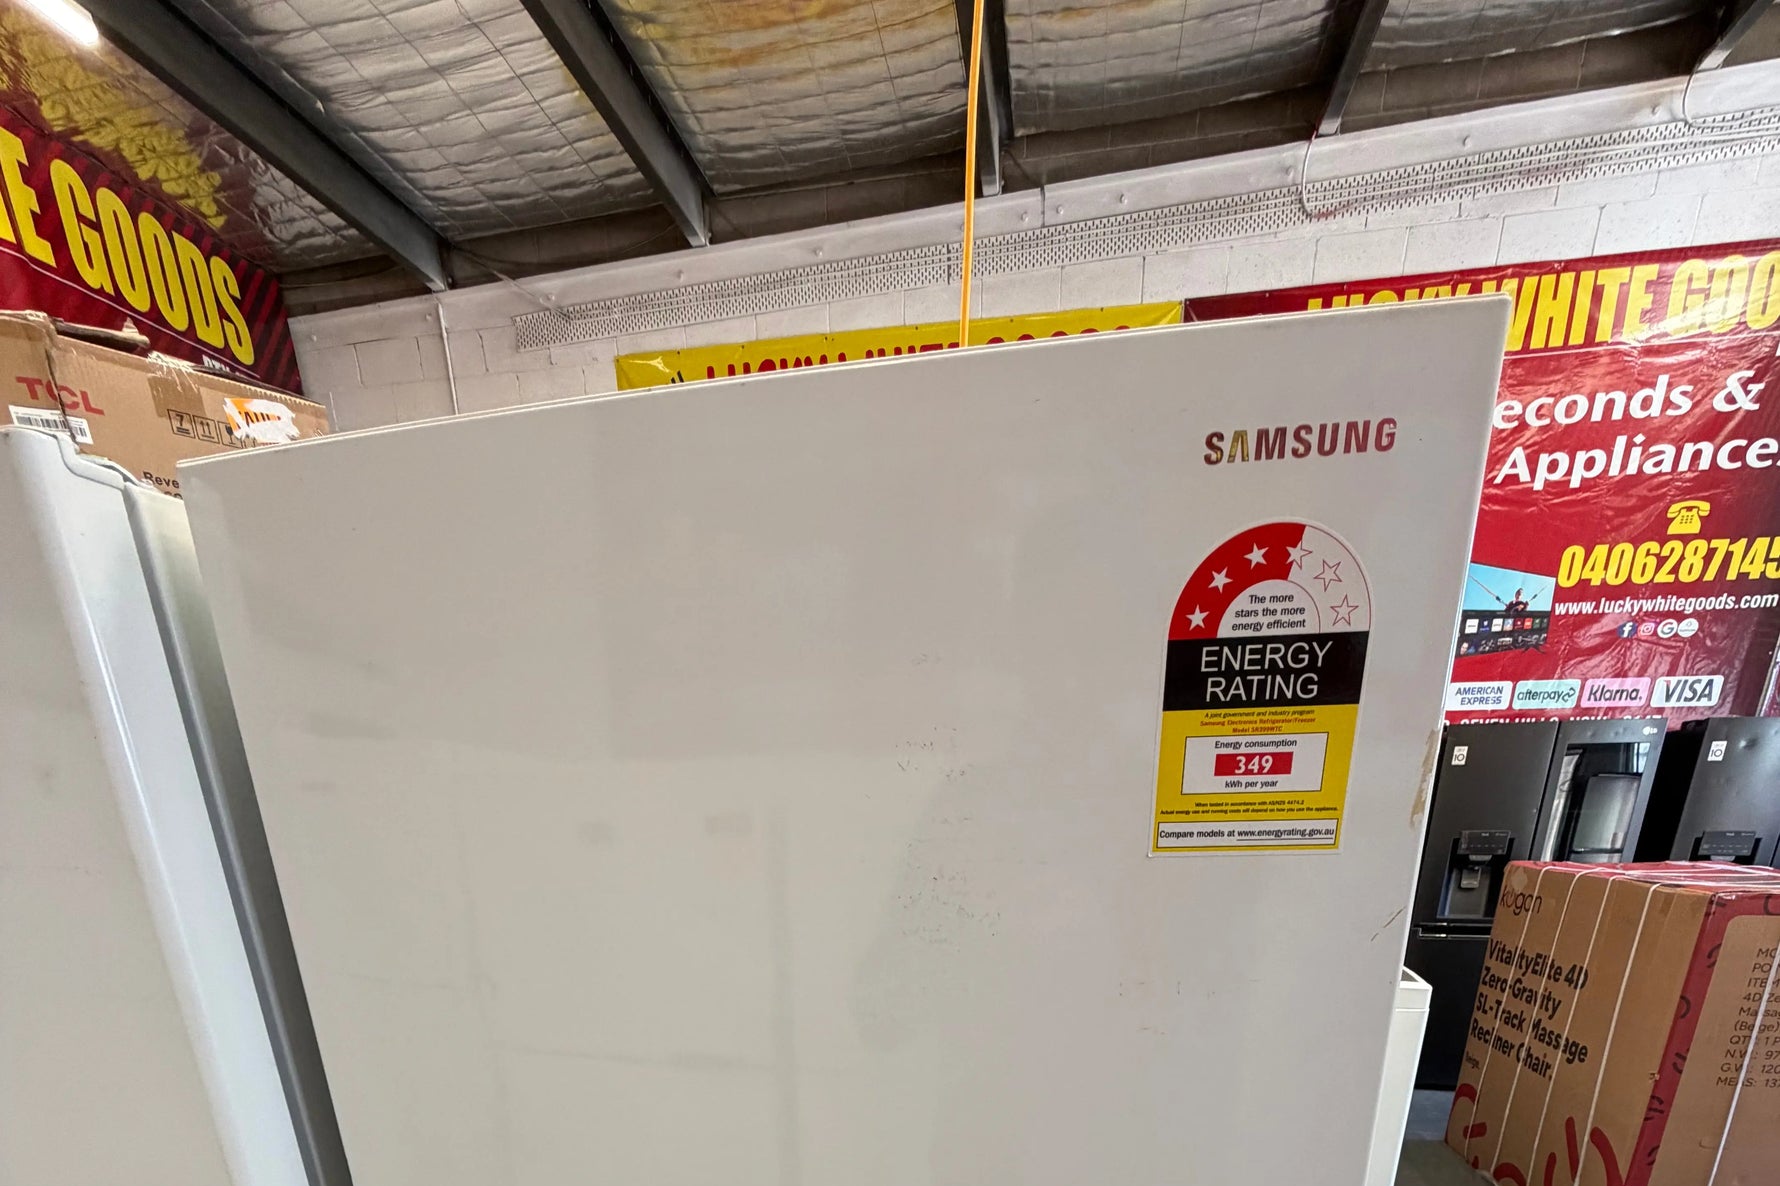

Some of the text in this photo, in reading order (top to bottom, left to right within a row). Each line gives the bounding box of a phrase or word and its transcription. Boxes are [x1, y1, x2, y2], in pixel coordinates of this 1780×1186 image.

[50, 159, 254, 365] GOODS
[15, 376, 105, 416] TCL
[1493, 370, 1765, 429] econds &
[1203, 417, 1397, 466] SAMSUNG
[1493, 433, 1780, 491] Appliance
[1249, 594, 1294, 604] The more
[1554, 593, 1779, 616] www.luckywhitegoods.com
[1234, 607, 1306, 618] stars the more
[1231, 619, 1306, 632] energy efficient
[1201, 641, 1333, 672] ENERGY
[1206, 672, 1319, 702] RATING
[1455, 686, 1504, 696] AMERICAN
[1517, 688, 1563, 703] afterpay
[1587, 684, 1643, 702] Klarna.
[1664, 678, 1714, 703] VISA
[1460, 696, 1503, 705] EXPRESS
[1214, 739, 1297, 750] Energy consumption
[1234, 755, 1273, 774] 349
[1225, 780, 1278, 789] kWh per year
[1159, 827, 1335, 840] Compare models at www.energyrating.gov.au
[1564, 963, 1589, 990] 4D
[1476, 992, 1588, 1064] SL-Track Massage
[1734, 1020, 1780, 1033] (Bege)
[1716, 1076, 1757, 1087] MES:
